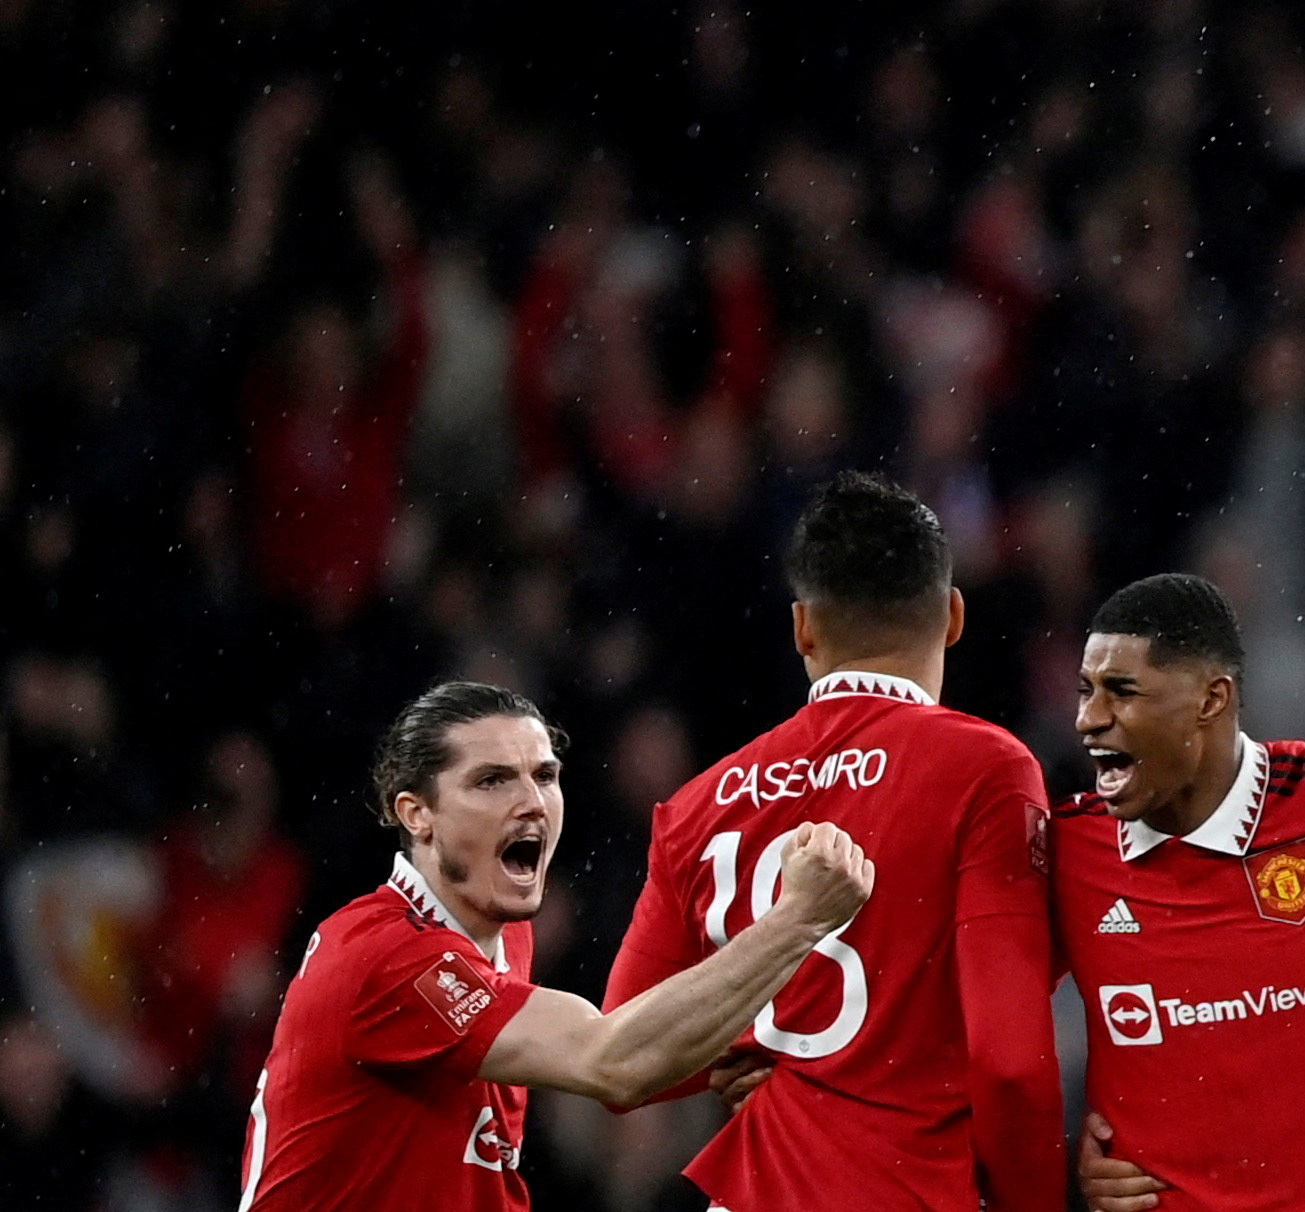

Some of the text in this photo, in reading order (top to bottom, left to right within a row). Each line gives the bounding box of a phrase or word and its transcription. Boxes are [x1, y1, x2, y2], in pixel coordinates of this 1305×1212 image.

[715, 748, 888, 810] CASEMIRO
[1098, 919, 1140, 934] adidas
[454, 994, 491, 1028] FA CUP
